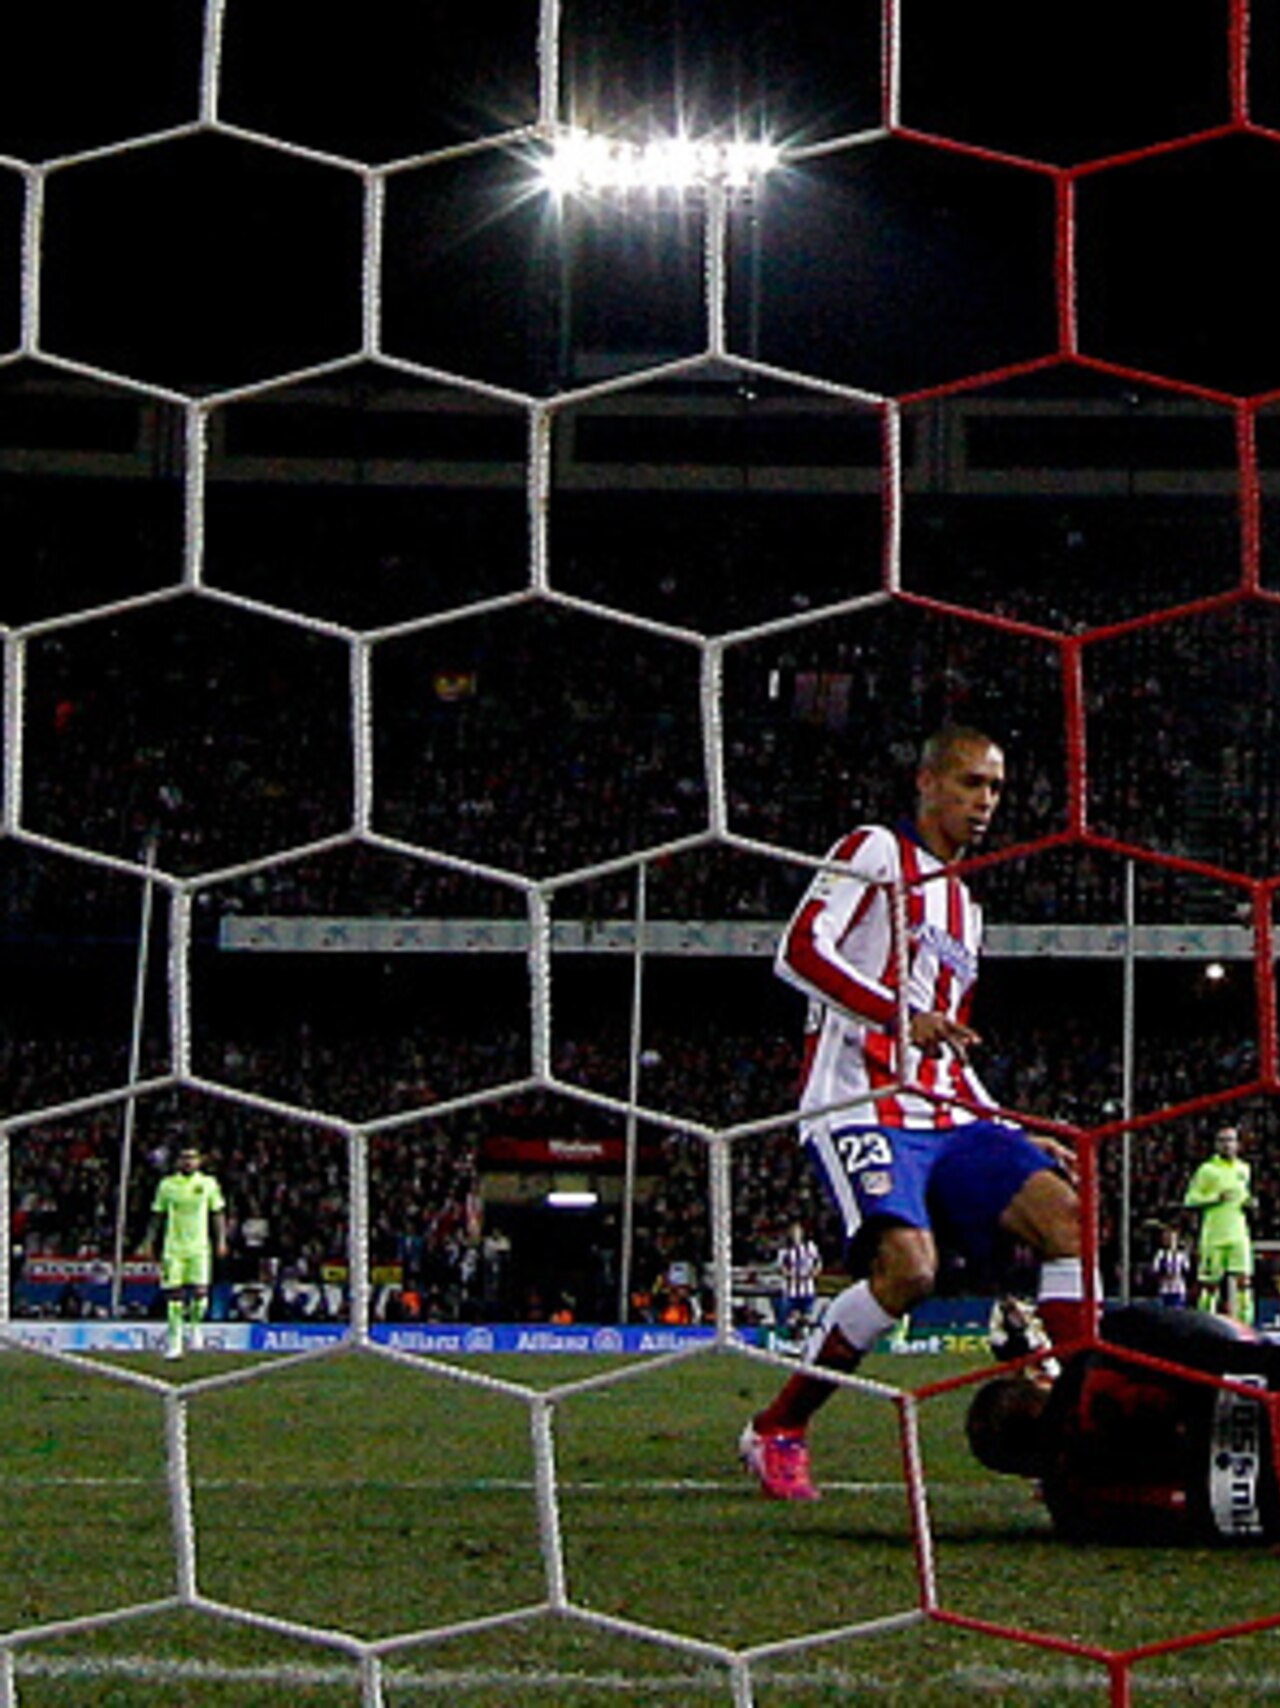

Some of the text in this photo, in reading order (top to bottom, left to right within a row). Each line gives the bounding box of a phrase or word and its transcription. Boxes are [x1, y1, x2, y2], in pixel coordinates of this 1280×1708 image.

[838, 1132, 892, 1173] 23
[389, 1331, 459, 1350] Allianz
[517, 1331, 589, 1350] Allianz
[639, 1331, 714, 1350] Allia
